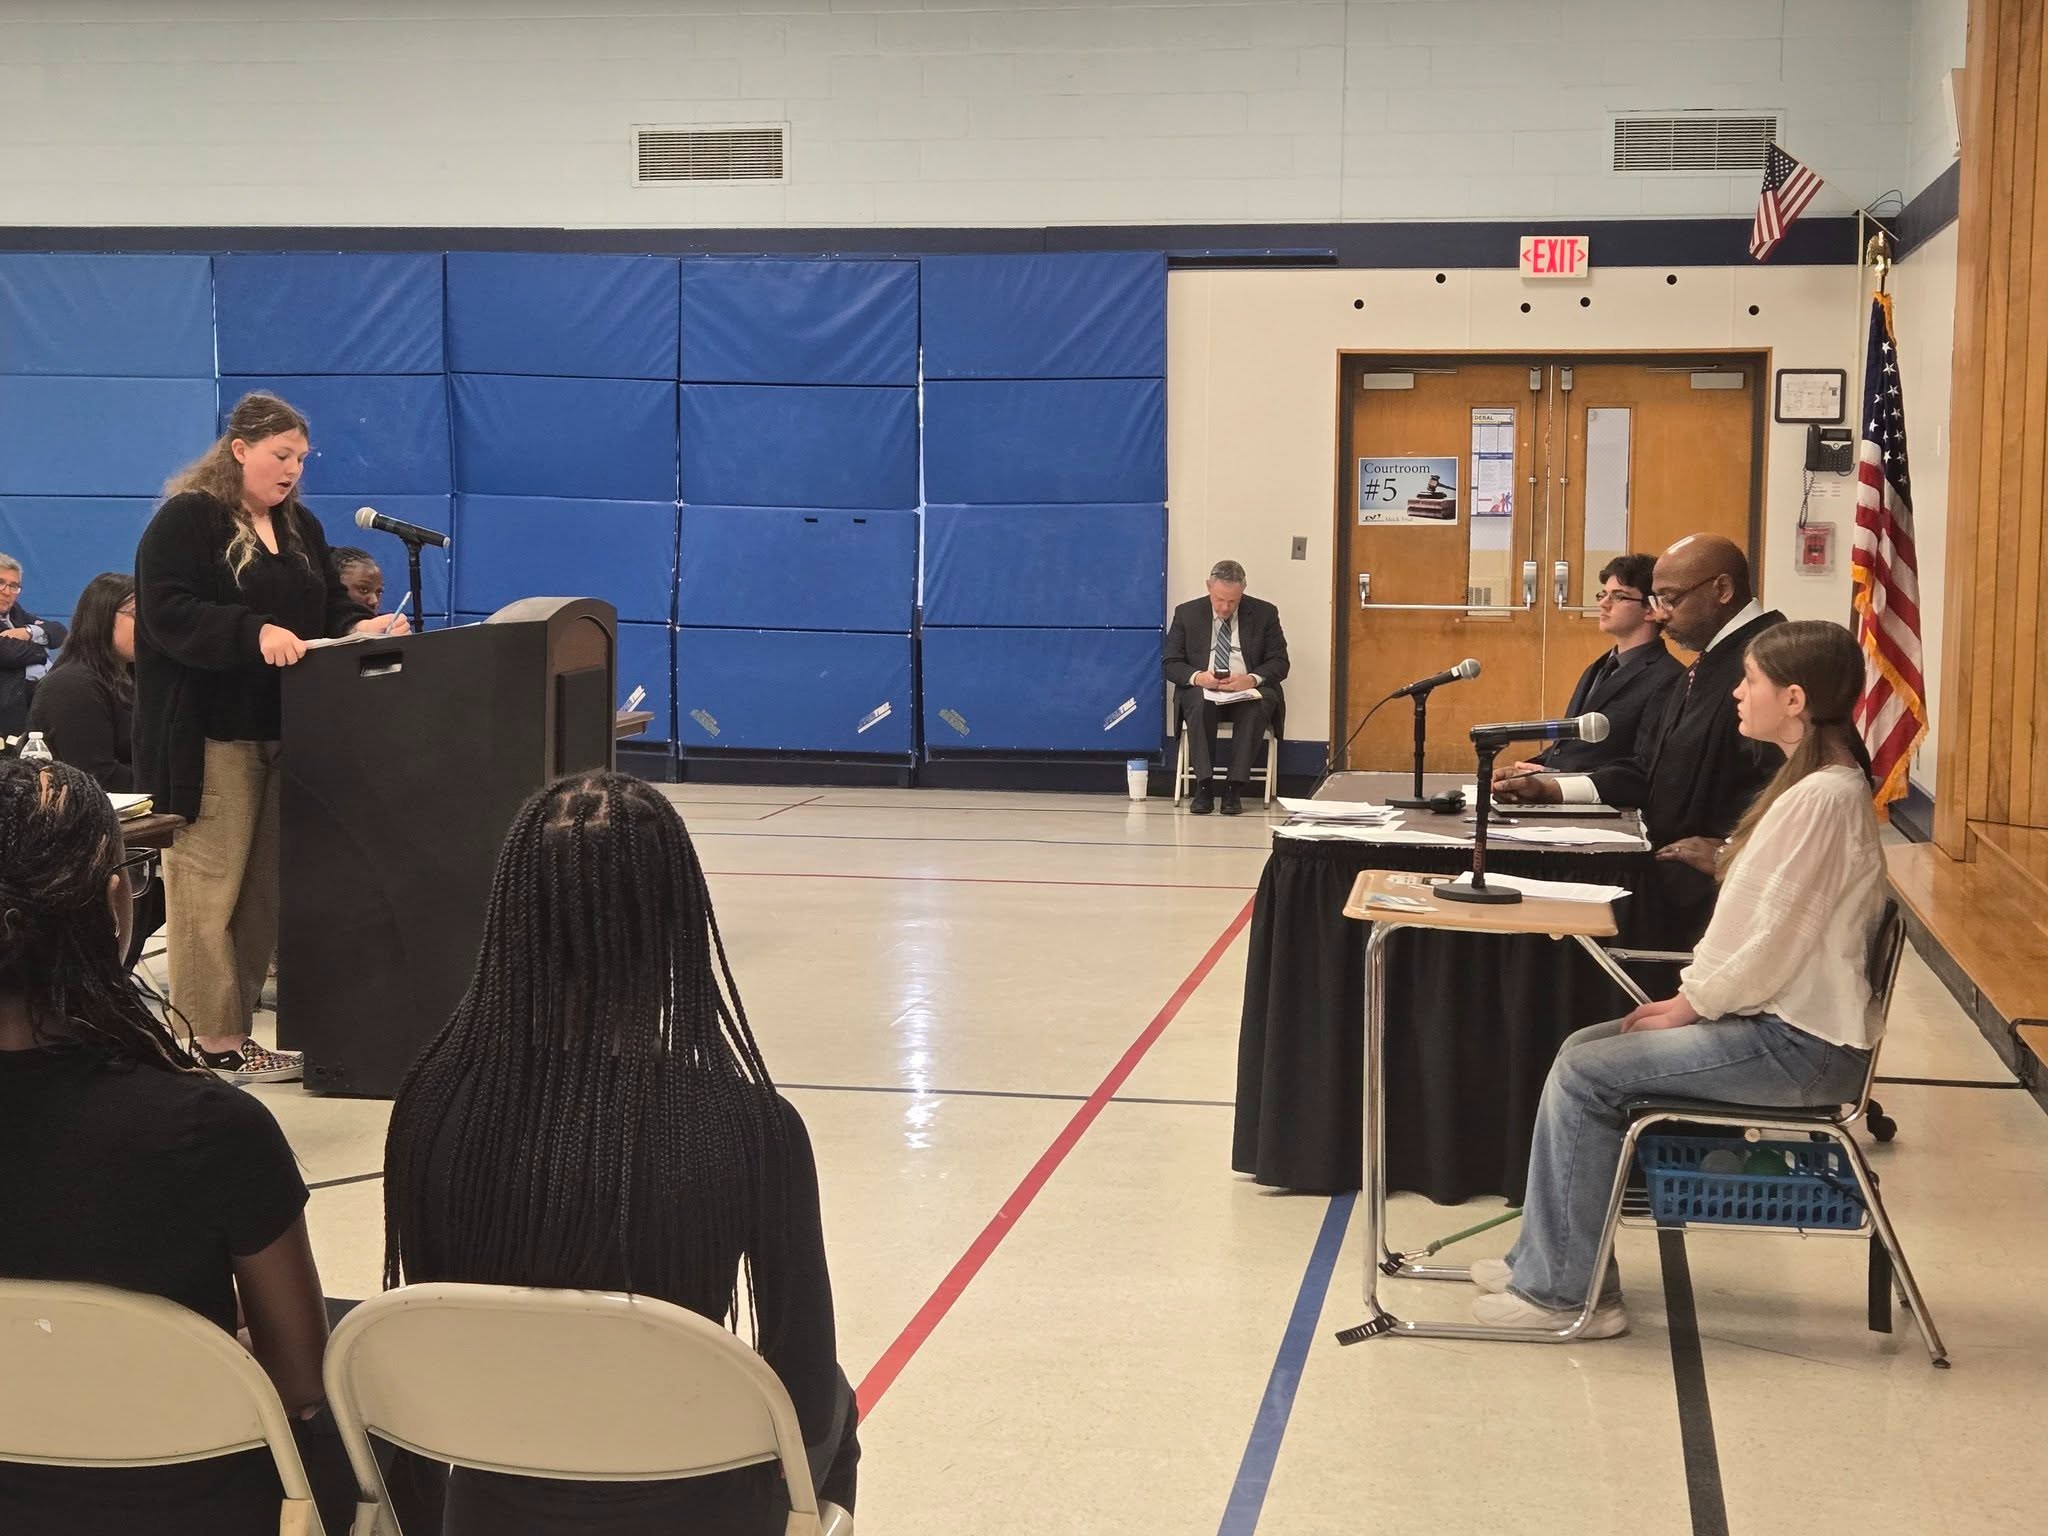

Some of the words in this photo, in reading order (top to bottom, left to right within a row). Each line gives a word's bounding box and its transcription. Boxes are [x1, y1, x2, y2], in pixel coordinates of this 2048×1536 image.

[1533, 239, 1578, 273] EXIT
[1364, 462, 1430, 474] Courtroom
[1365, 478, 1397, 502] #5
